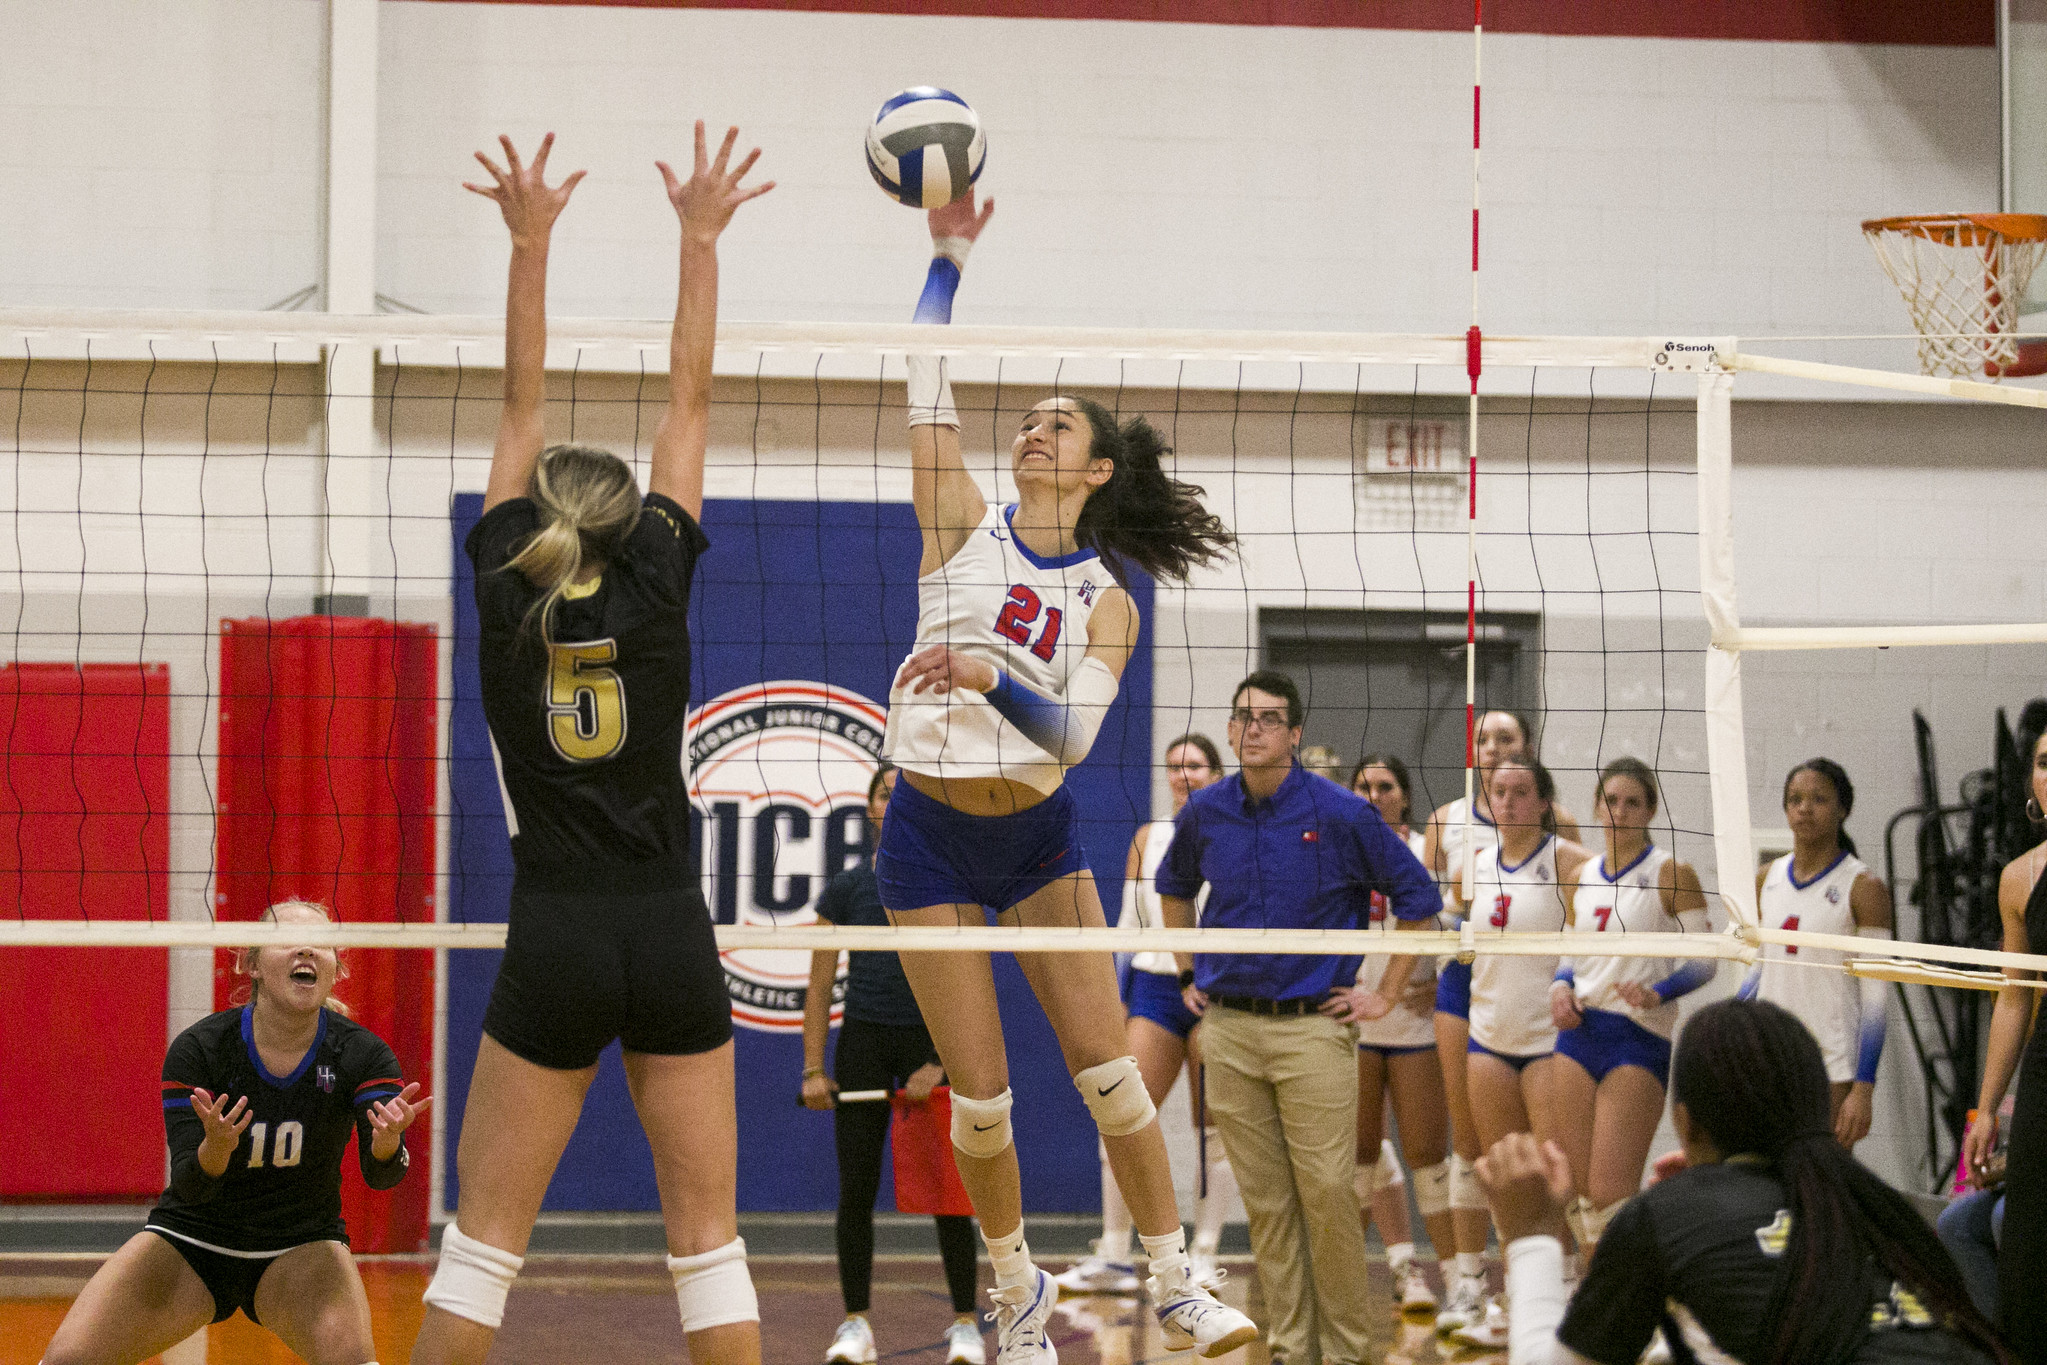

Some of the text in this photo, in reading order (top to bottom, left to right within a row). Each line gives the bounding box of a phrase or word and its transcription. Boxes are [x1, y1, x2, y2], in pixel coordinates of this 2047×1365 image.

[1676, 343, 1715, 352] Senoh
[1386, 422, 1445, 467] EXIT
[993, 582, 1063, 664] 21
[546, 637, 628, 763] 5
[766, 709, 840, 734] JUNIOR
[1594, 905, 1612, 932] 7
[247, 1120, 304, 1168] 10
